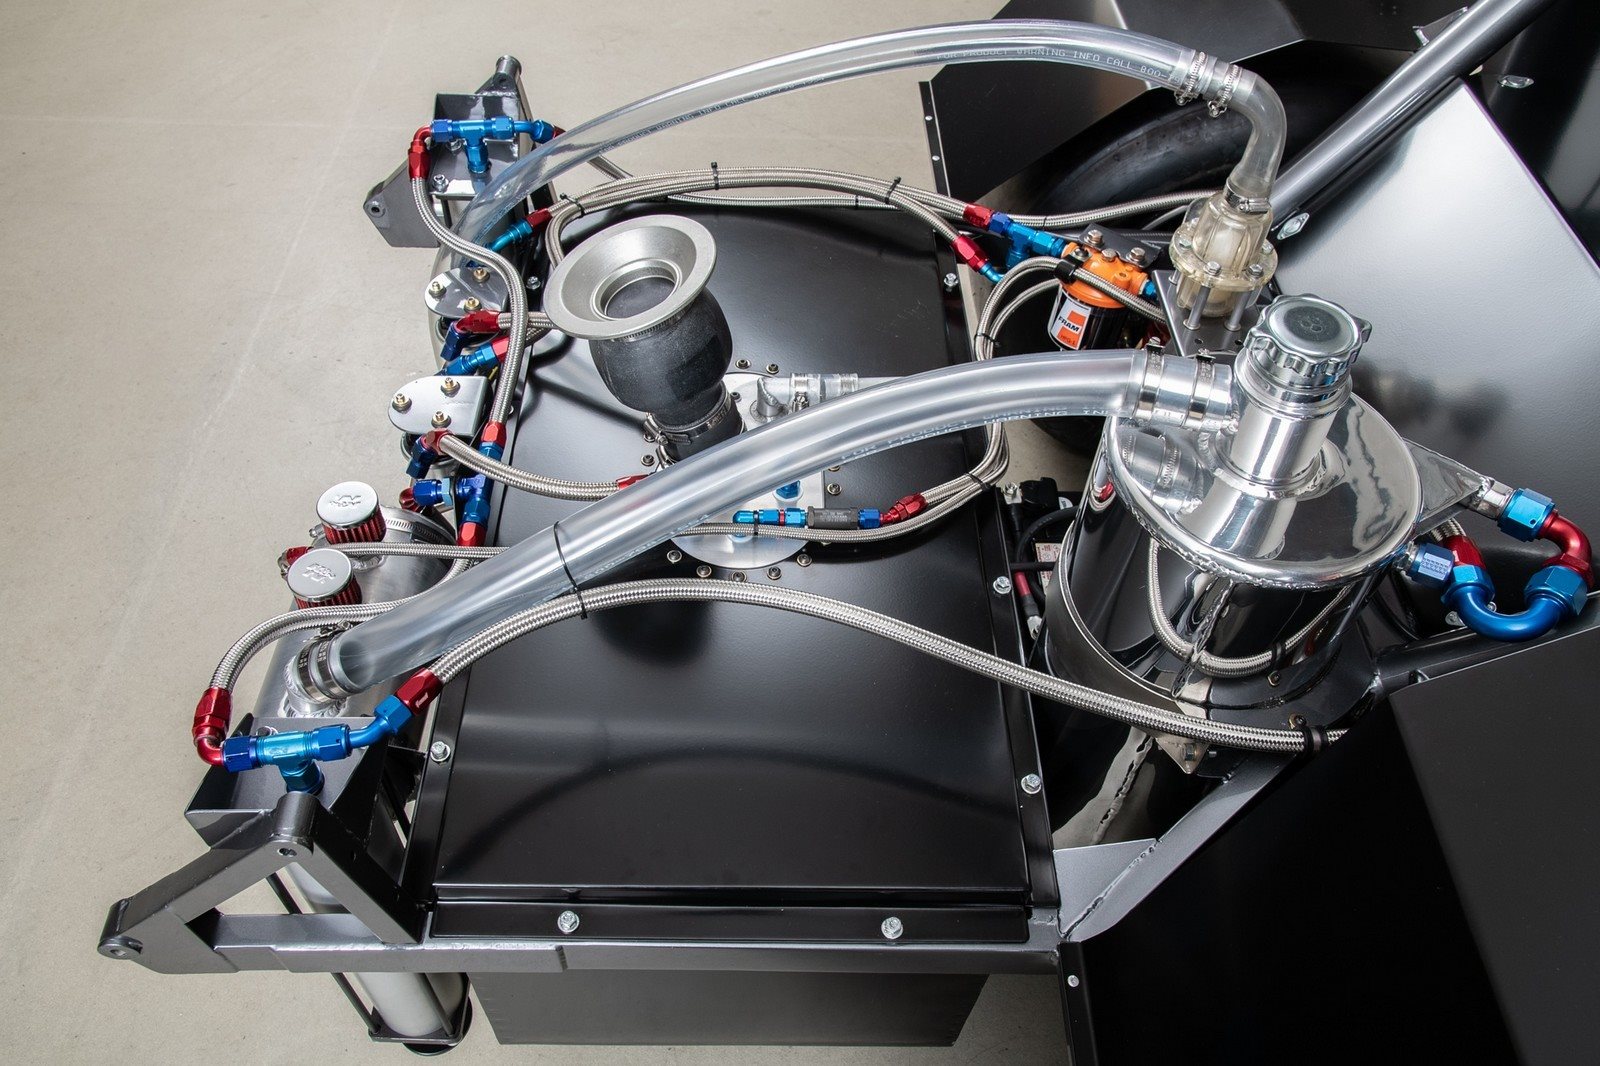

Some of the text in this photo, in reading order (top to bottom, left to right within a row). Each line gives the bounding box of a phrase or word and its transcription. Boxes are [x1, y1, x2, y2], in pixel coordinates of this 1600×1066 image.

[963, 48, 1008, 57] PRODUCT
[1016, 47, 1066, 57] WARNING
[1073, 50, 1100, 62] INFO
[1106, 57, 1134, 70] CALL
[1058, 316, 1080, 332] FRAM
